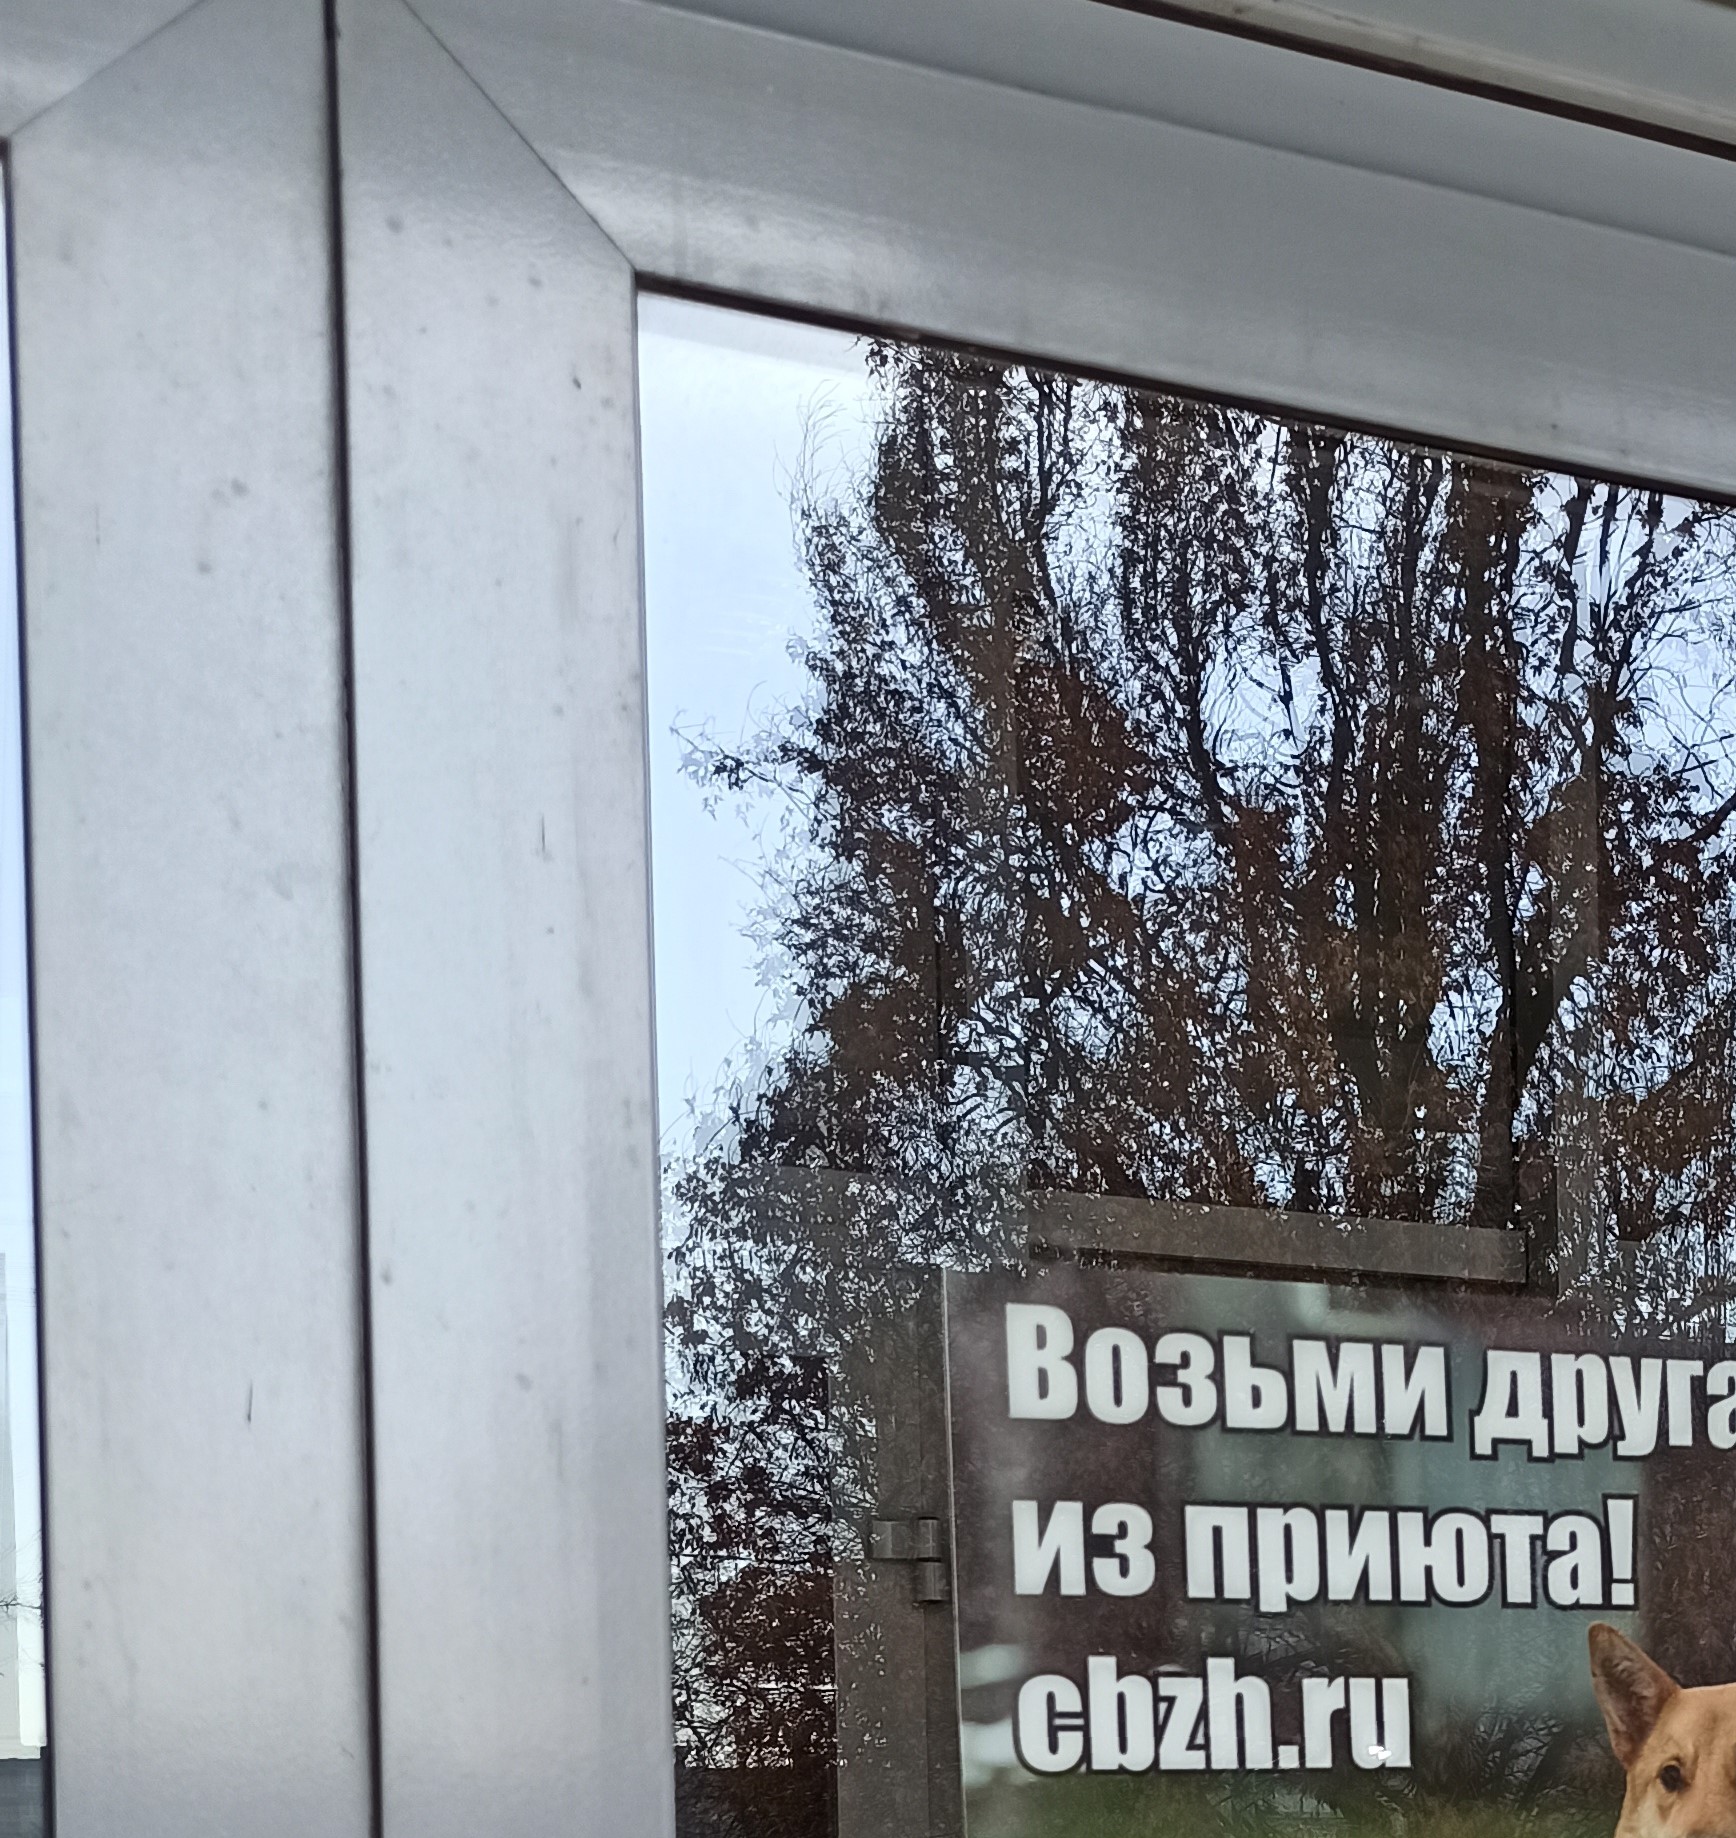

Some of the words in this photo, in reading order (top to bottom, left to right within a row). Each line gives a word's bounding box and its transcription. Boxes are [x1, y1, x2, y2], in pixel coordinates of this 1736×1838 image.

[1007, 1304, 1448, 1434] Возьми
[1012, 1500, 1156, 1598] из
[1187, 1499, 1634, 1611] приюта!
[1018, 1655, 1411, 1771] cbzh.ru
